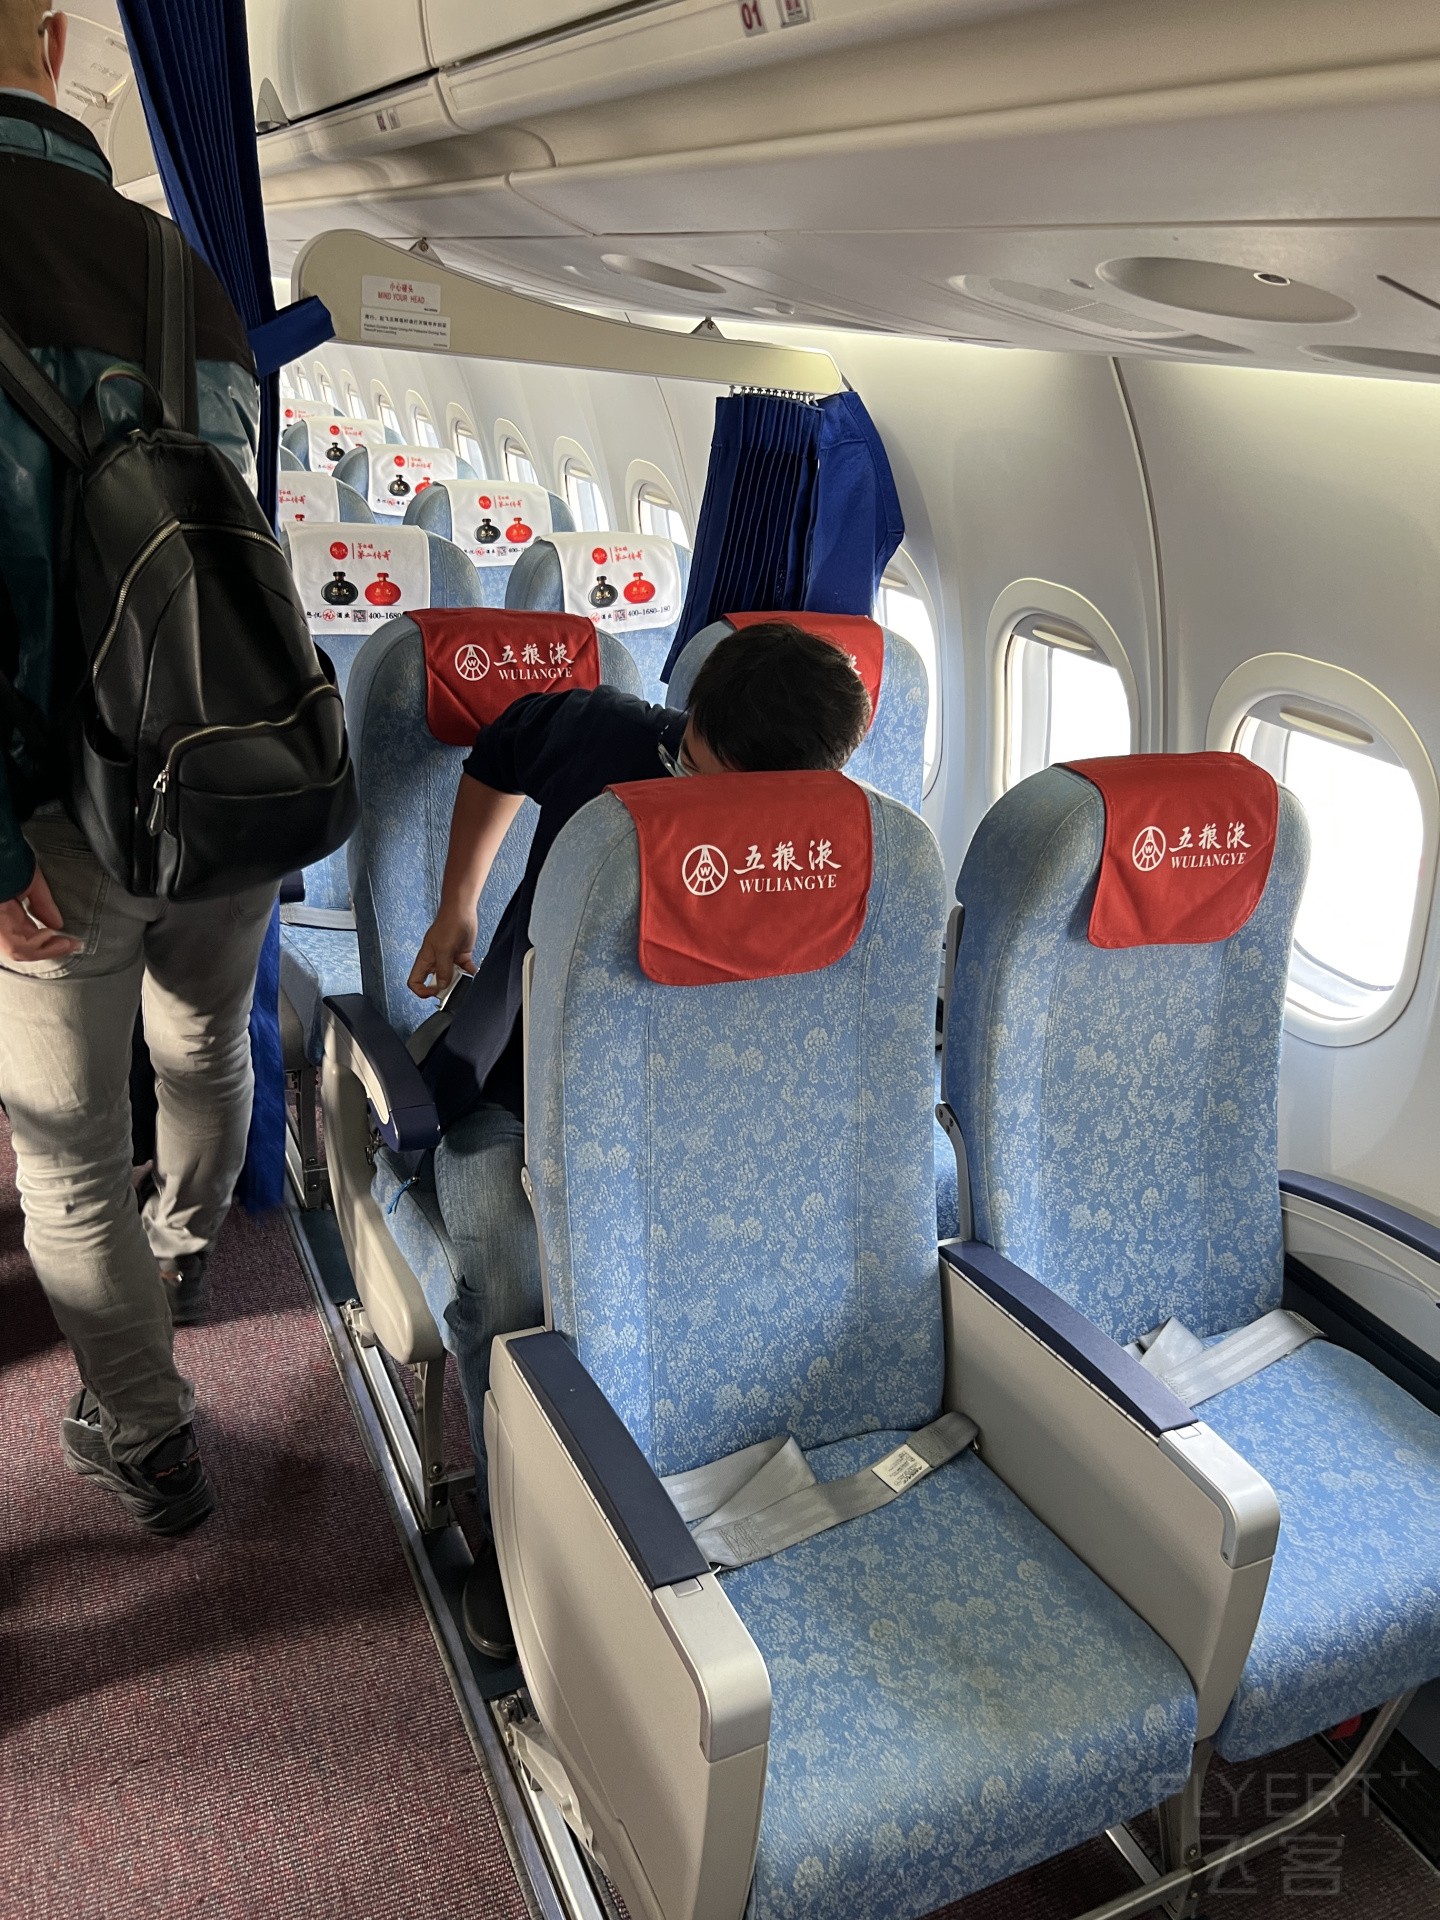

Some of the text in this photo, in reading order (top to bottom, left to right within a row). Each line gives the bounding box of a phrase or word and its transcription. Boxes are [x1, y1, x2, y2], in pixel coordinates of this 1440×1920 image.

[741, 0, 762, 30] 01
[378, 291, 426, 304] MIND YOUR HEAD
[493, 642, 575, 667] 五粮液
[498, 667, 573, 680] WULIANGYE
[1168, 821, 1252, 853] 五粮液
[733, 838, 842, 875] 五粮液
[1170, 852, 1247, 869] WULIANGYE
[739, 874, 837, 894] WULIANGYE
